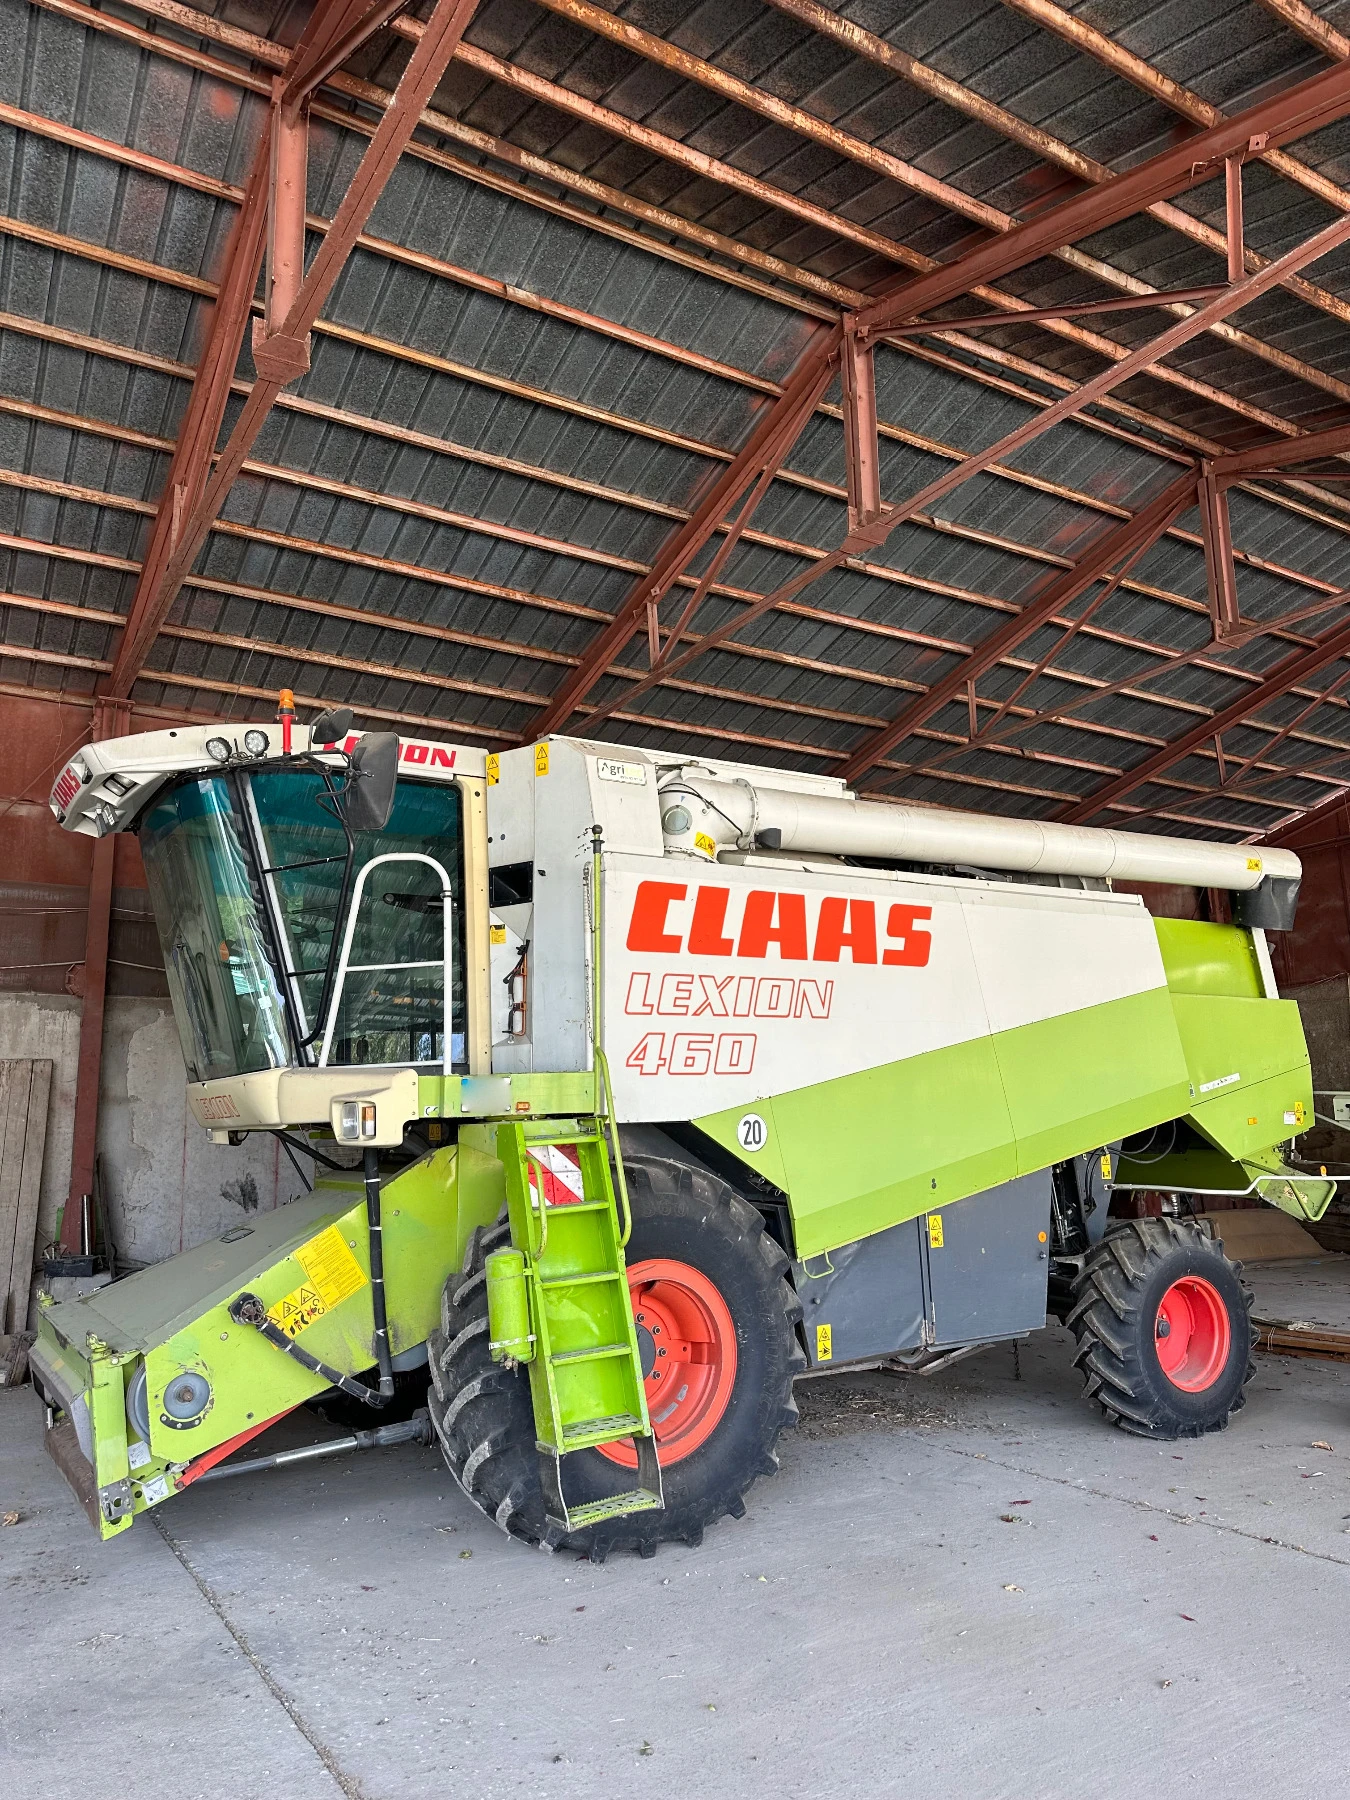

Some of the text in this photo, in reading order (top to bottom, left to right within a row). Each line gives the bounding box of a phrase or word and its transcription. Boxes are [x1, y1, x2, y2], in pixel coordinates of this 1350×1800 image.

[53, 767, 81, 811] CLAAS
[626, 880, 932, 967] CLAAS
[624, 972, 834, 1019] LEXION
[626, 1032, 757, 1075] 460
[743, 1120, 761, 1145] 20
